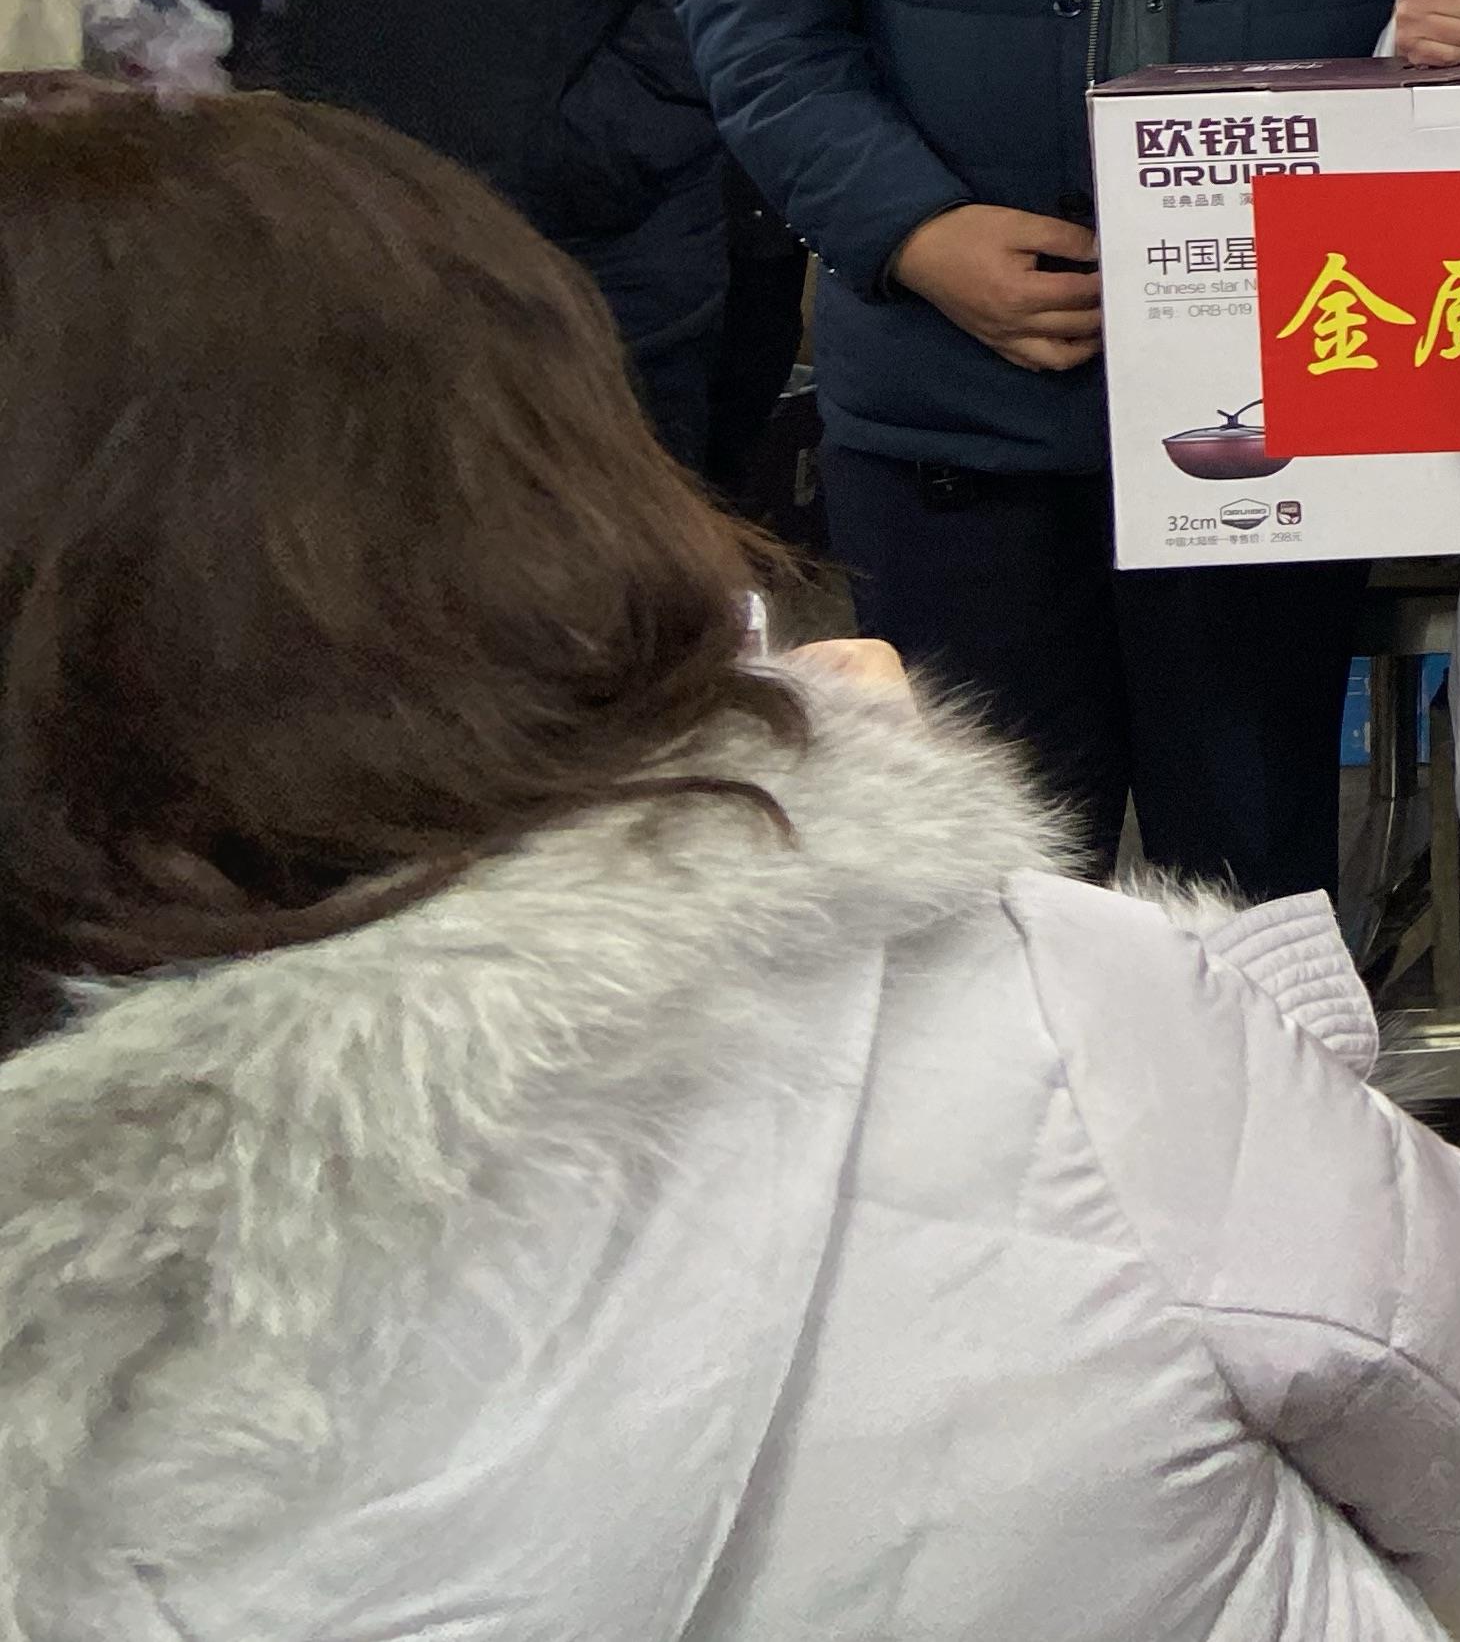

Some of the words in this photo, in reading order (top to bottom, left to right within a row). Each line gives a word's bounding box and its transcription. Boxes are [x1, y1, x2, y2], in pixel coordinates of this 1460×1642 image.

[1135, 115, 1319, 158] 欧锐铂
[1162, 192, 1225, 208] 经典品质
[1147, 237, 1257, 275] 中国星
[1143, 281, 1206, 296] Chinese
[1211, 279, 1239, 293] star
[1167, 515, 1216, 531] 32cm
